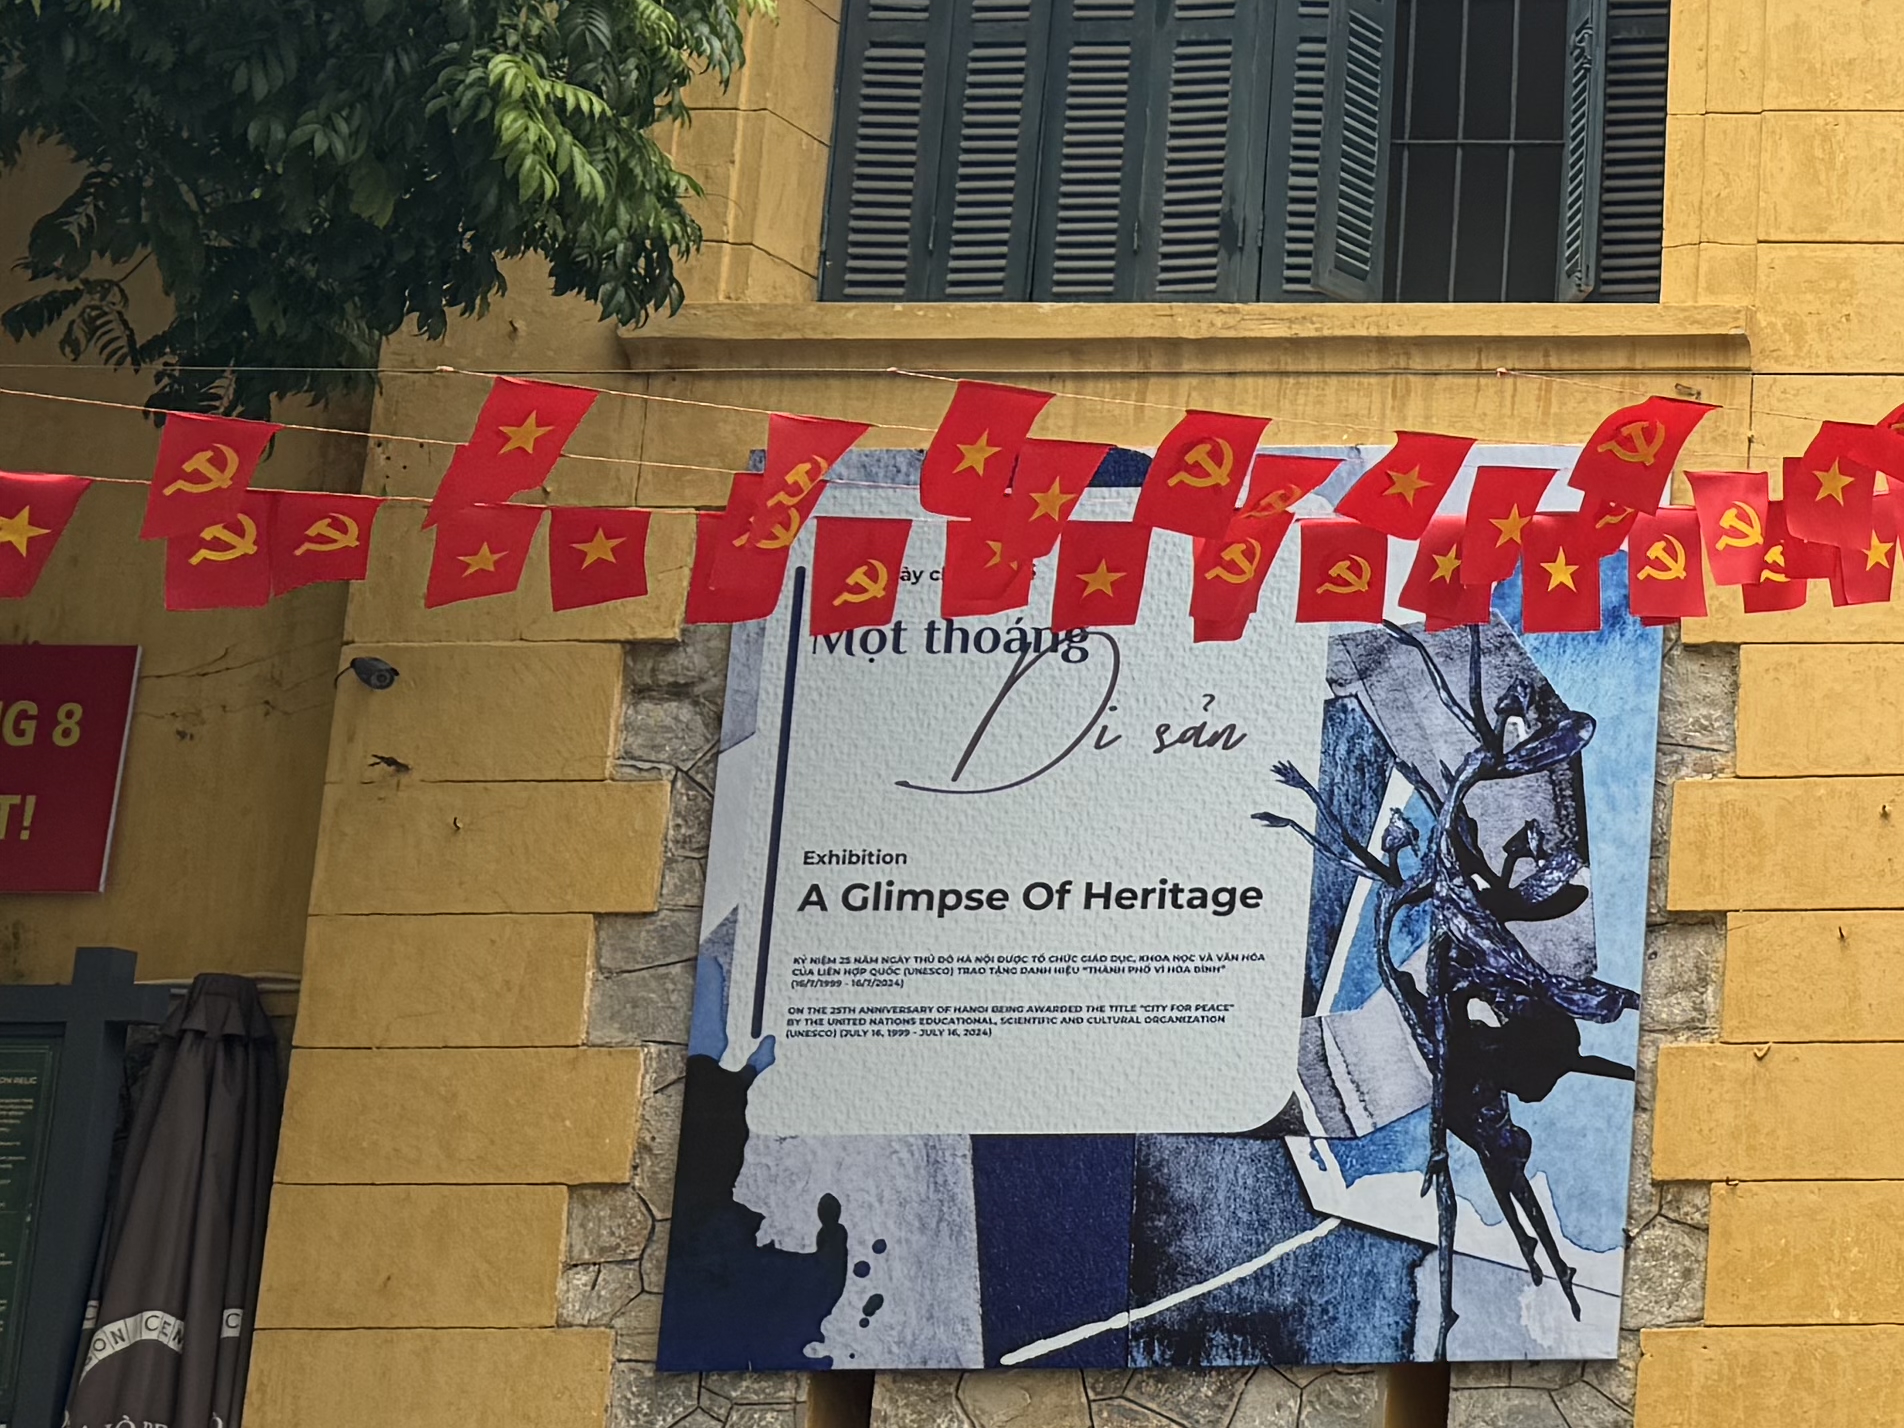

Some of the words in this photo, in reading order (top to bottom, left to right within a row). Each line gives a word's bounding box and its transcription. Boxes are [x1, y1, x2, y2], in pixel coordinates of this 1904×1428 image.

[924, 617, 1089, 664] thoáng
[52, 702, 84, 747] 8
[895, 630, 1122, 795] Di
[1152, 693, 1248, 754] sản
[802, 848, 908, 867] Exhibition
[797, 883, 829, 913] A
[841, 879, 1010, 918] Glimpse
[1022, 879, 1072, 912] Of
[1083, 877, 1264, 917] Heritage
[786, 1018, 801, 1026] BY
[804, 1018, 824, 1026] THE
[827, 1018, 867, 1026] UNITED
[869, 1017, 917, 1026] NATIONS
[919, 1017, 998, 1026] EDUCATIONAL,
[1060, 1016, 1084, 1025] AND
[1086, 1015, 1141, 1024] CULTURAL
[1144, 1015, 1226, 1024] ORGANIZATION
[787, 1006, 804, 1014] ON
[807, 1006, 828, 1014] THE
[858, 1005, 934, 1014] ANNIVERSARY
[936, 1005, 952, 1013] OF
[953, 1005, 989, 1013] HANOI
[1026, 1005, 1083, 1013] AWARDED
[1085, 1004, 1106, 1013] THE
[1170, 1004, 1192, 1012] FOR
